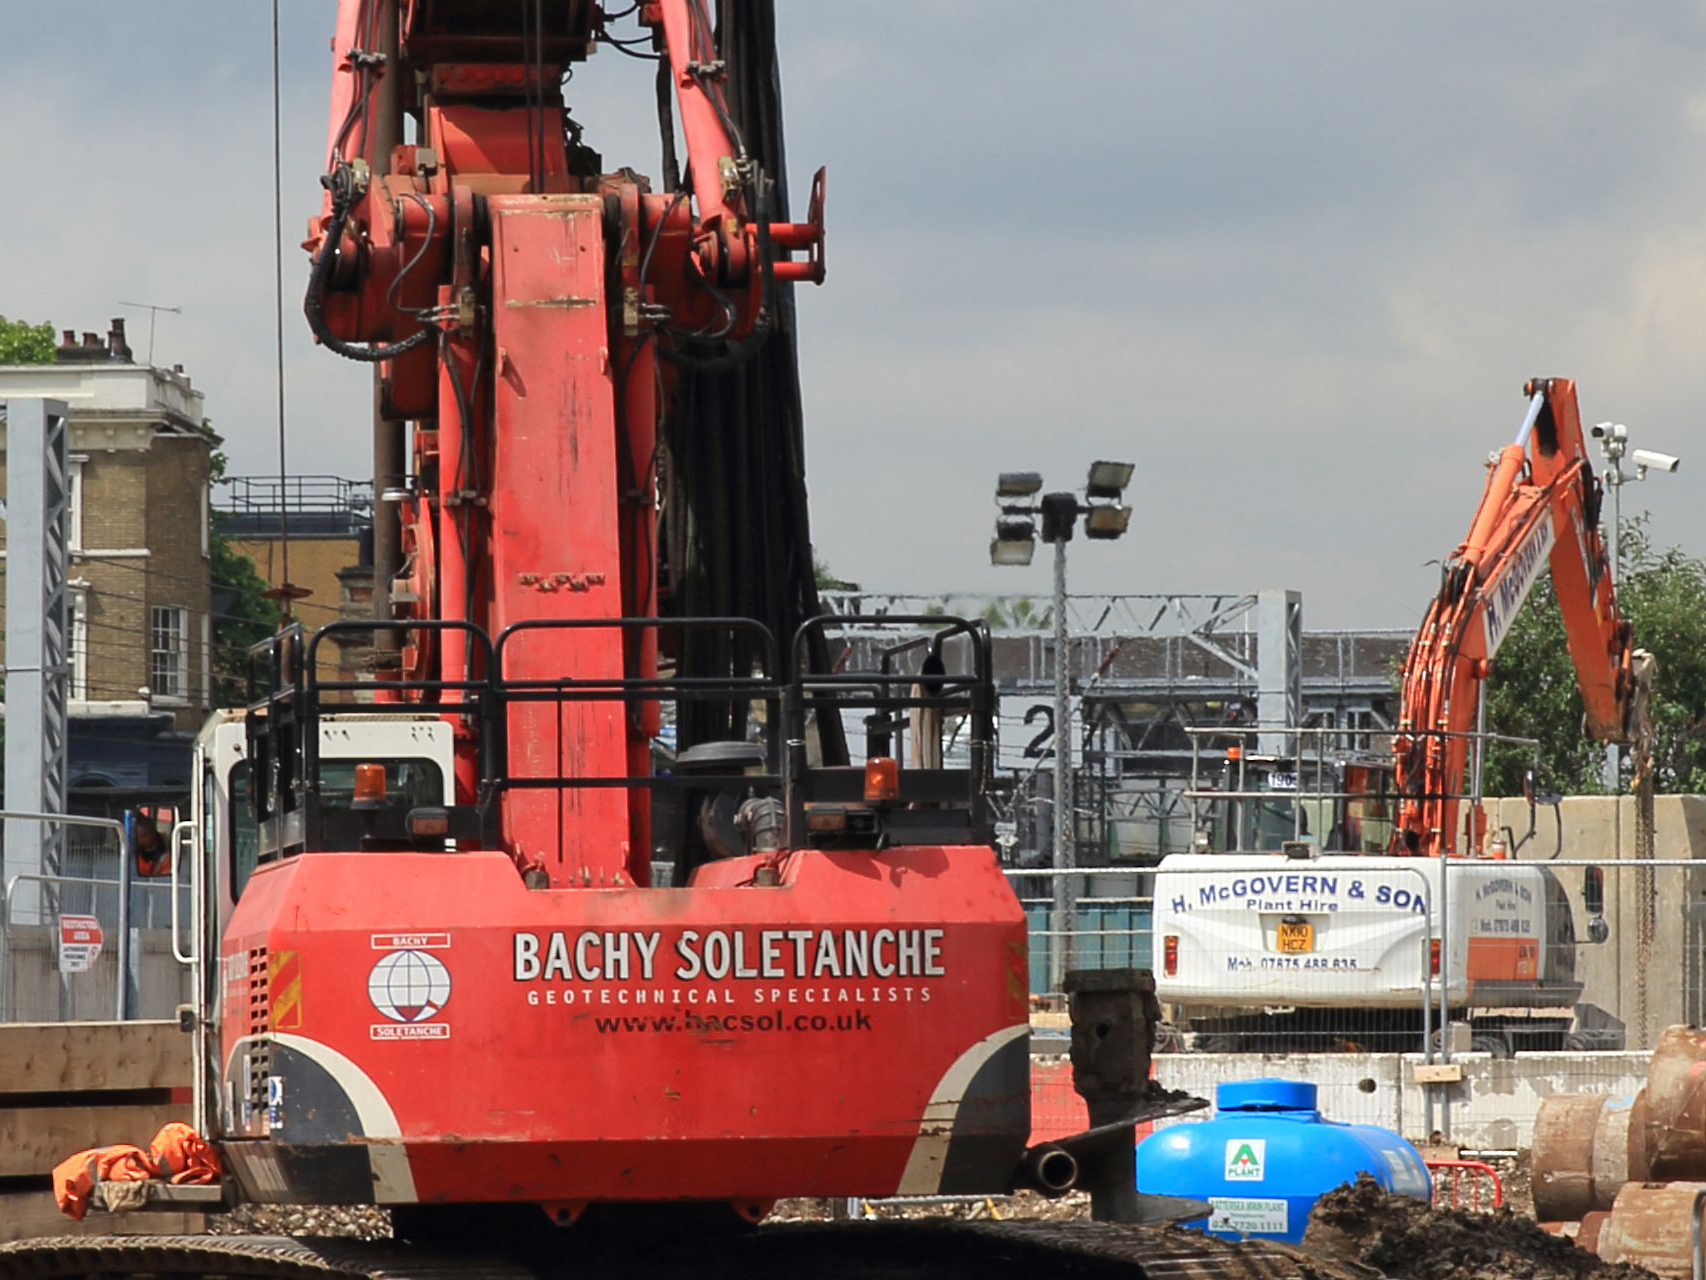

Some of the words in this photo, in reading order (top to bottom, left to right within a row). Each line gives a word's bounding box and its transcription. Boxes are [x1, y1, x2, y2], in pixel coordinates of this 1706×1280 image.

[1024, 704, 1056, 758] 2
[1199, 875, 1338, 906] McGOVERN
[1348, 880, 1365, 899] &
[1246, 899, 1293, 912] Plant
[1300, 899, 1339, 912] Hire
[393, 937, 428, 946] BACHY
[514, 930, 661, 981] BACHY
[675, 929, 945, 980] SOLETANCHE
[528, 989, 735, 1005] GEOTECHNICAL
[755, 987, 931, 1003] SPECIALISTS
[596, 1009, 872, 1034] www.bacsol.co.uk
[377, 1027, 443, 1037] SOLETANCHE
[1230, 1144, 1259, 1165] A
[1228, 1167, 1260, 1178] PLANT
